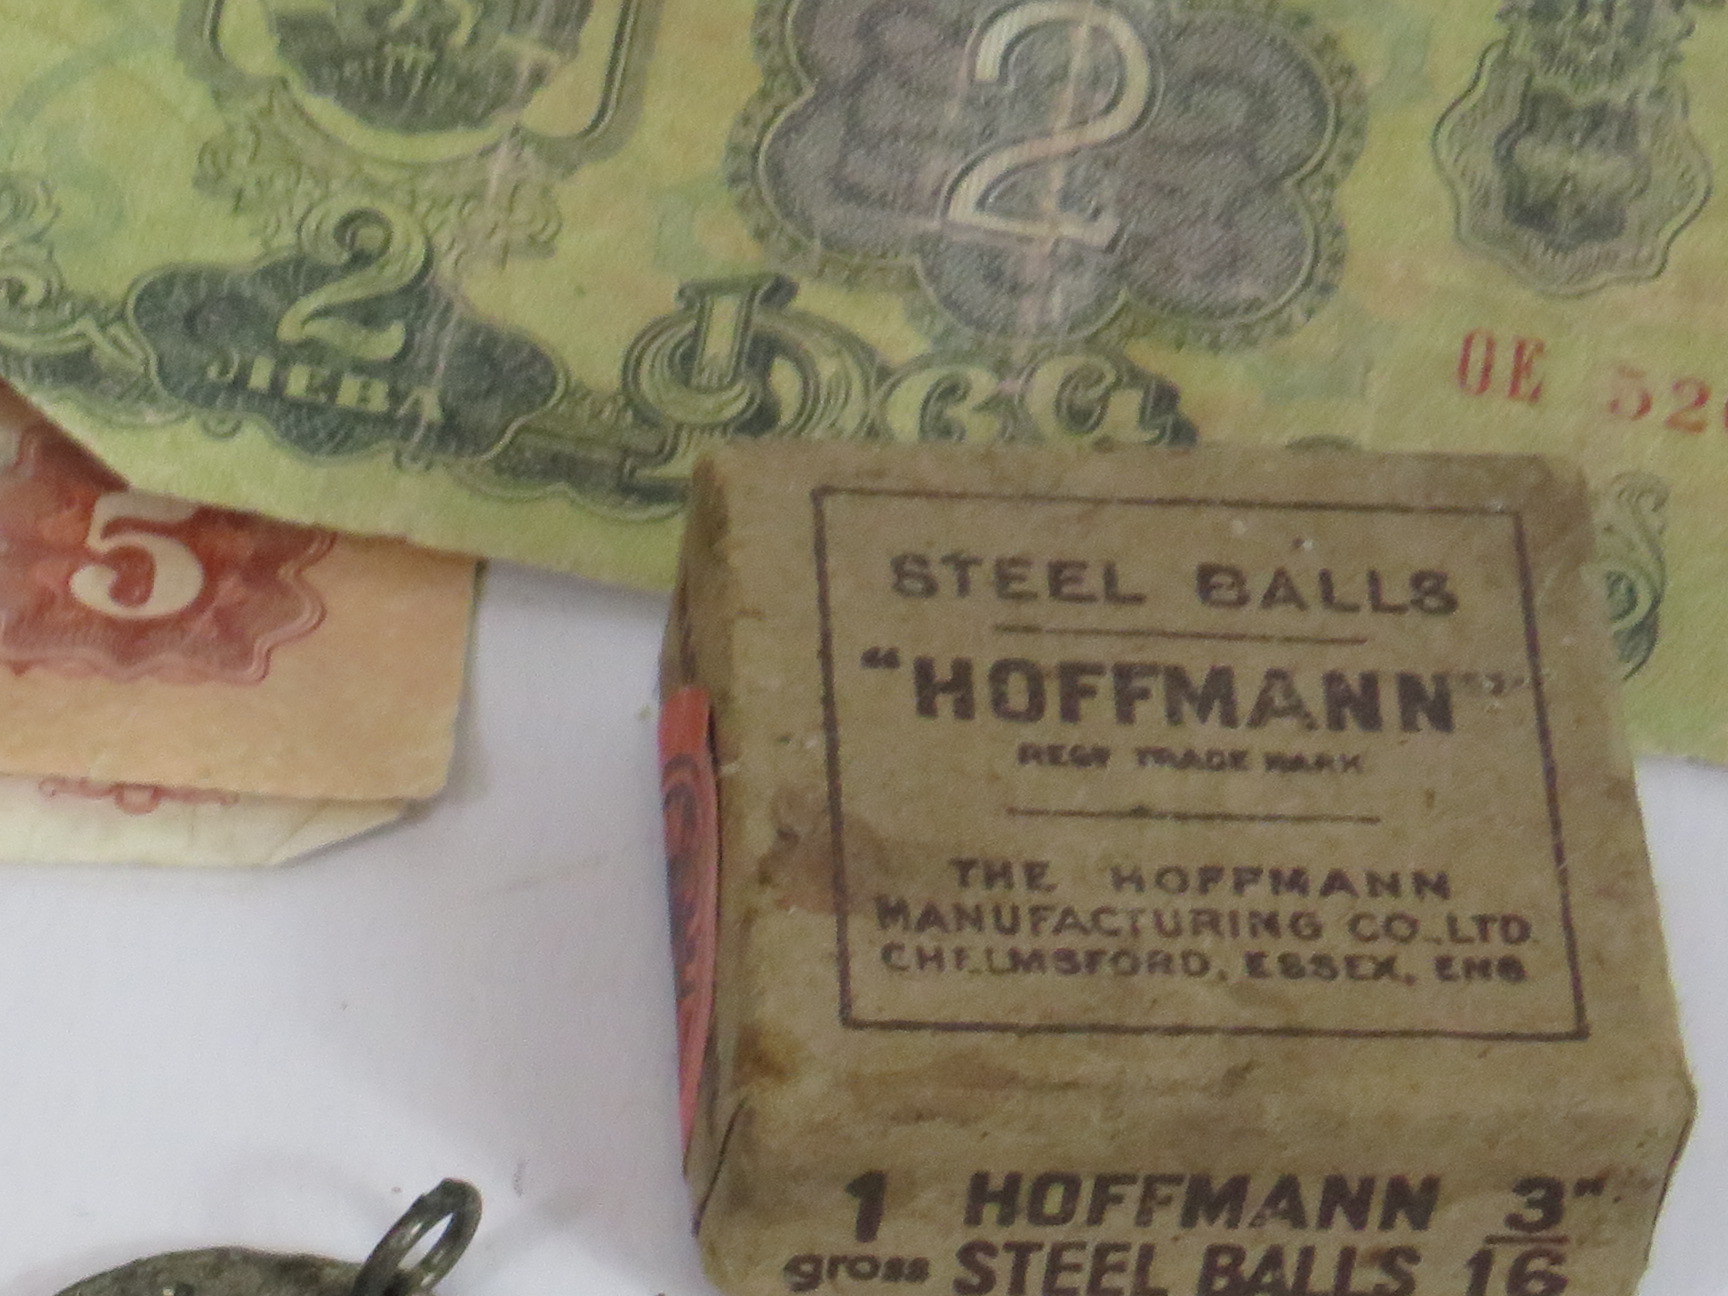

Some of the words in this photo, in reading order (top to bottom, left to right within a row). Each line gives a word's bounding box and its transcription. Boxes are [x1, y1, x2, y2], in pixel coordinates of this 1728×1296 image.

[946, 1, 1158, 244] 2
[275, 204, 430, 362] 2
[70, 488, 204, 621] 5
[889, 553, 1147, 606] STEEL
[1195, 561, 1459, 617] BALLS
[1135, 745, 1251, 772] TRADE
[1264, 749, 1366, 775] MARK
[949, 857, 1058, 894] THE
[1110, 863, 1452, 901] HOFFMANN
[876, 894, 1324, 943] MANUFACTURING
[844, 1169, 890, 1243] 1
[962, 1169, 1443, 1233] HOFFMANN
[784, 1246, 933, 1294] gross
